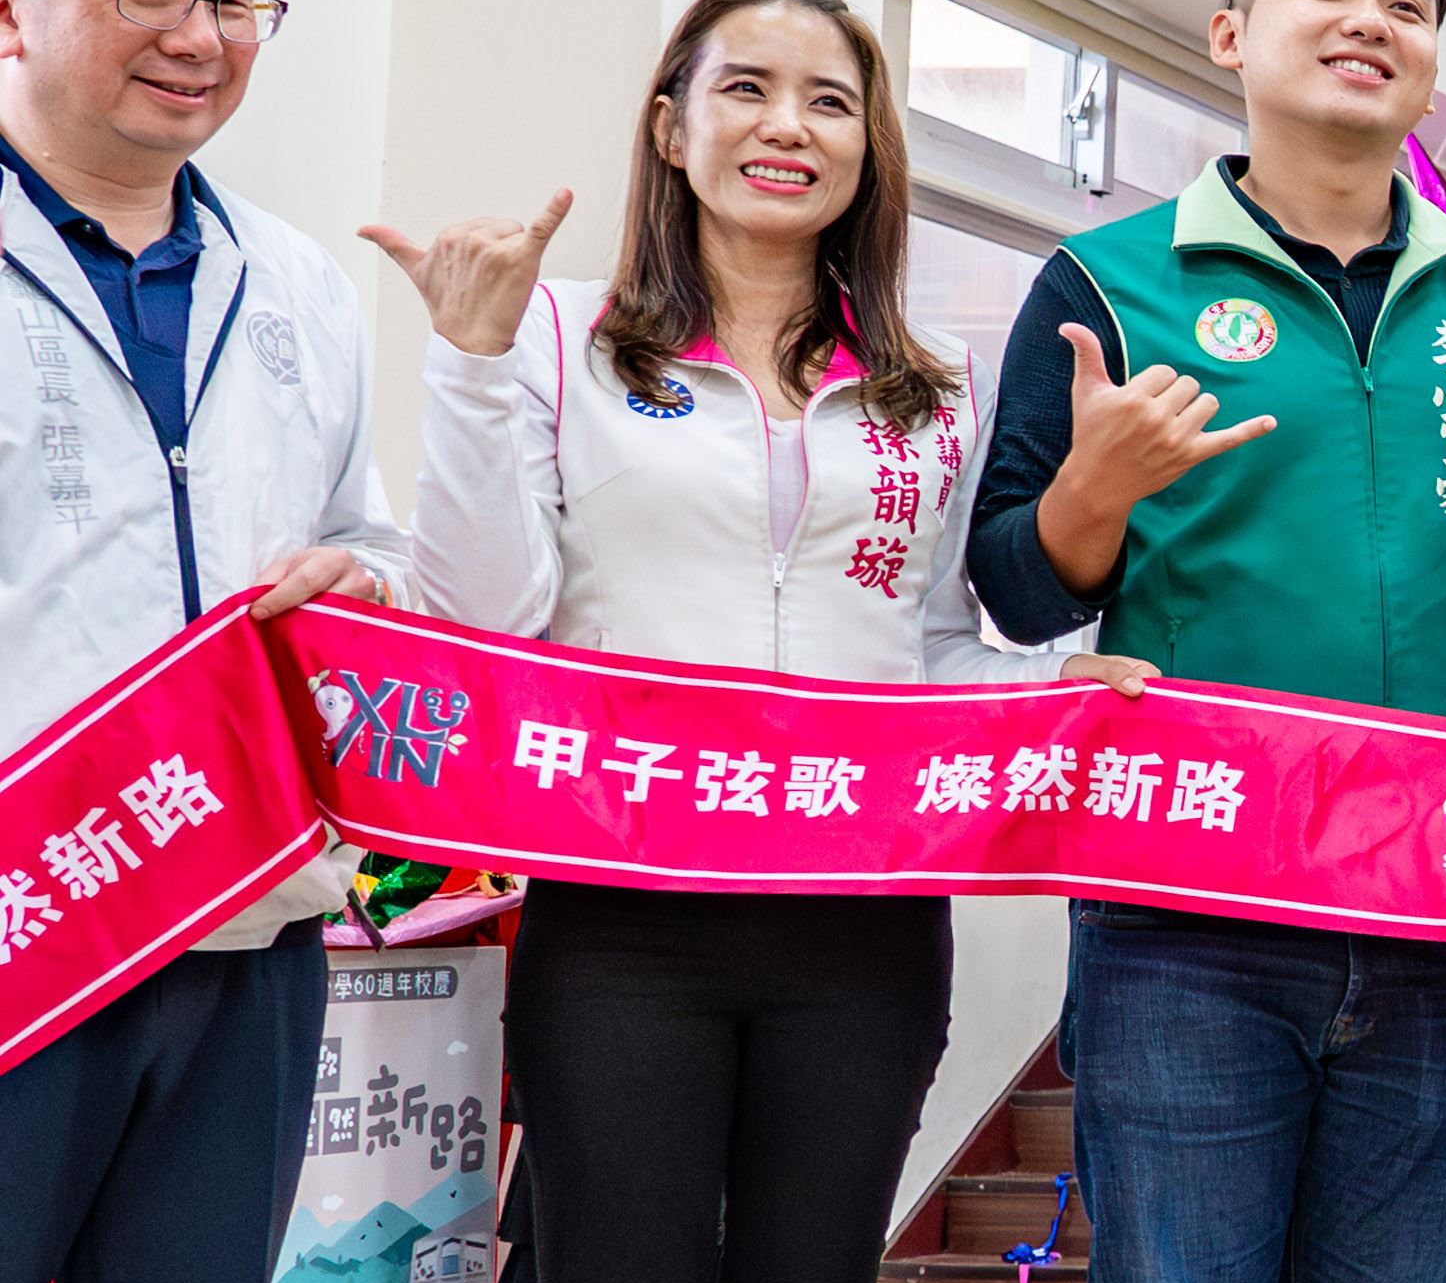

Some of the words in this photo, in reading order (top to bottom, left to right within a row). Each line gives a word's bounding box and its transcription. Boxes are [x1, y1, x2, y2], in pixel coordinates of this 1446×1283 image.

[42, 424, 100, 535] 張嘉平
[844, 418, 922, 600] 孫韻璇
[512, 719, 866, 817] 甲子弦歌
[914, 744, 1247, 834] 燦然新路
[328, 969, 452, 1000] 學60週年校慶
